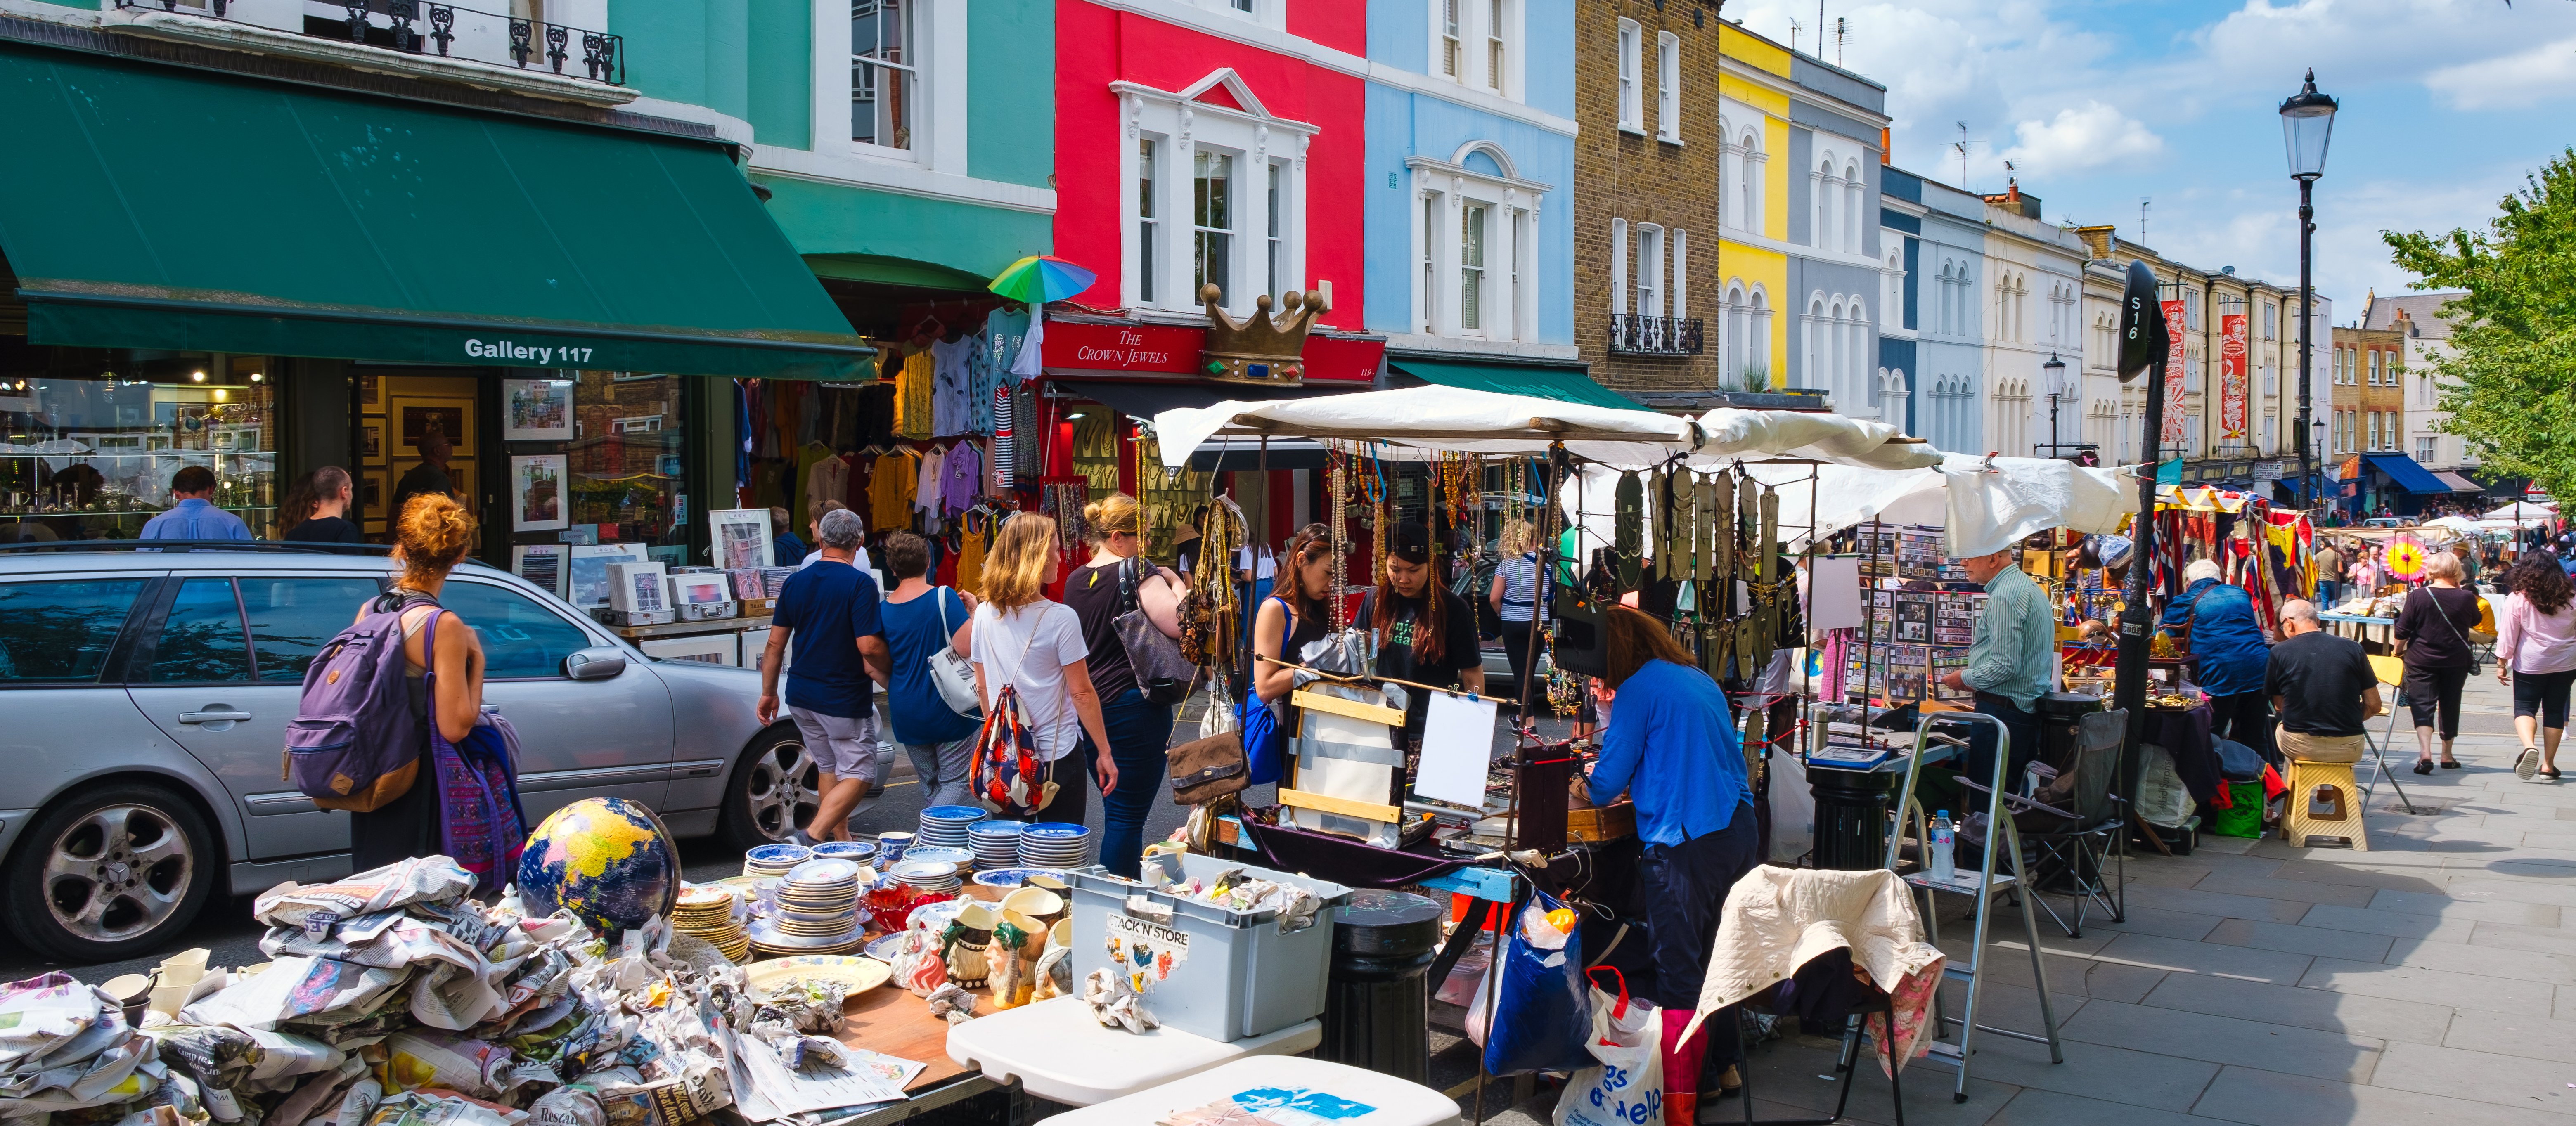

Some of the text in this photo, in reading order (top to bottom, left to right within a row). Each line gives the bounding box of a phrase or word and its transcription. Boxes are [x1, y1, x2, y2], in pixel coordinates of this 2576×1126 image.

[2129, 297, 2140, 339] S16
[1120, 331, 1142, 345] THE
[465, 339, 592, 364] Gallery 117
[1078, 346, 1168, 367] CROWN JEWELS
[1154, 926, 1189, 946] STORE
